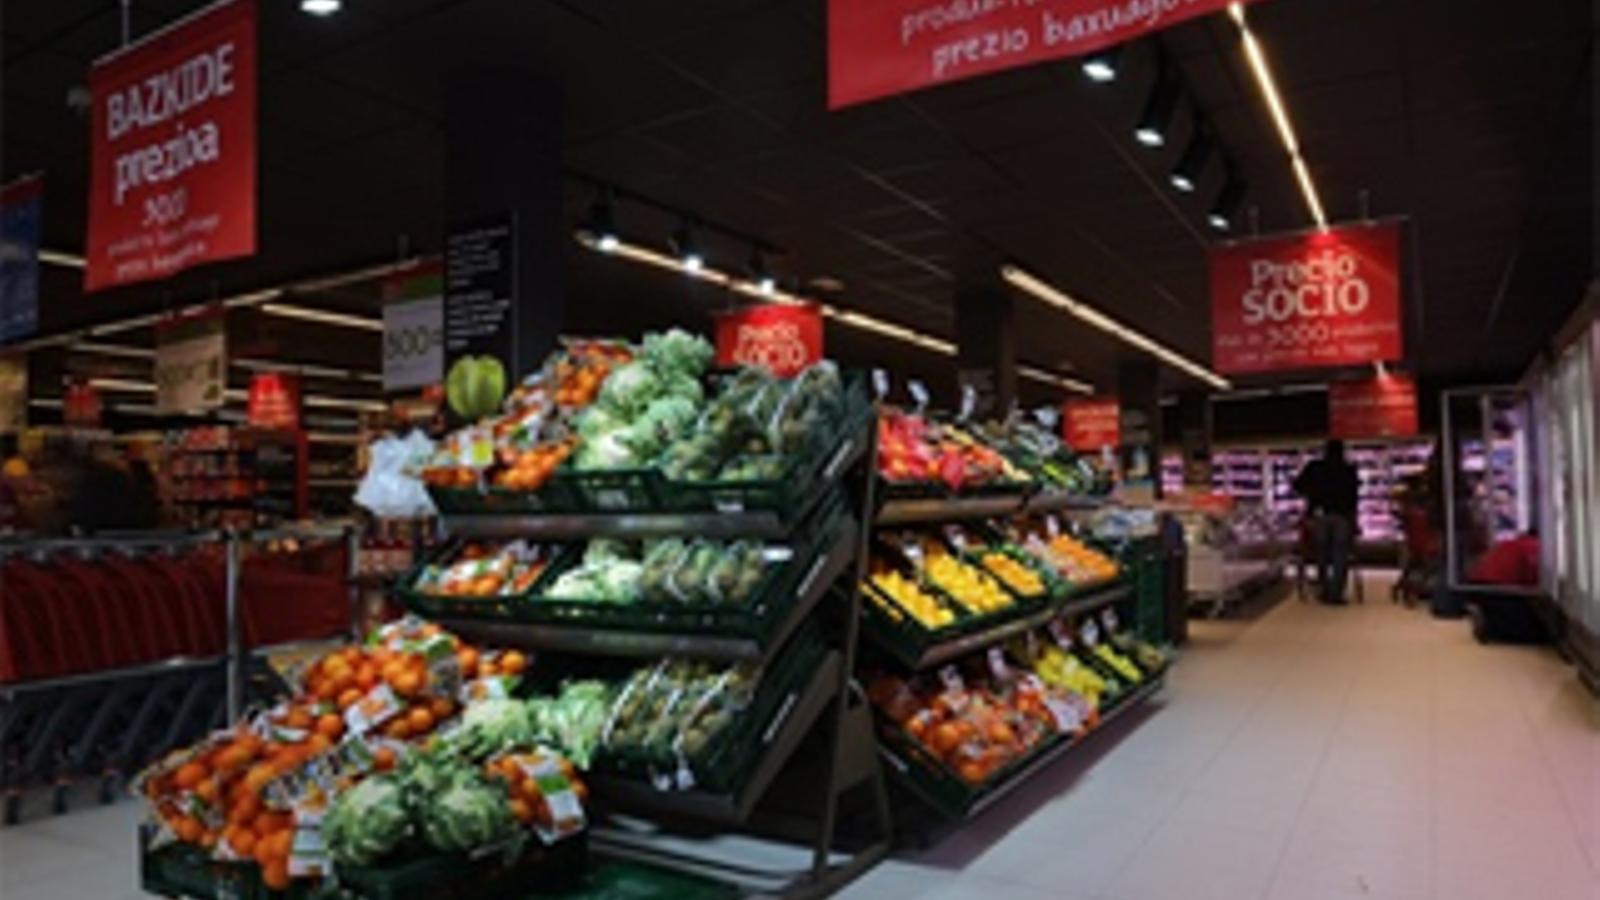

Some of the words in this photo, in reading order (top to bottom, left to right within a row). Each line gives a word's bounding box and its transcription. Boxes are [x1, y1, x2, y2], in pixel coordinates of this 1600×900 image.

[932, 26, 1030, 80] prezio
[1042, 0, 1198, 46] baxuago
[107, 44, 235, 141] BAZKIDE
[114, 119, 220, 206] prezioa
[1240, 277, 1370, 325] SOCIO
[1251, 248, 1356, 289] Precio
